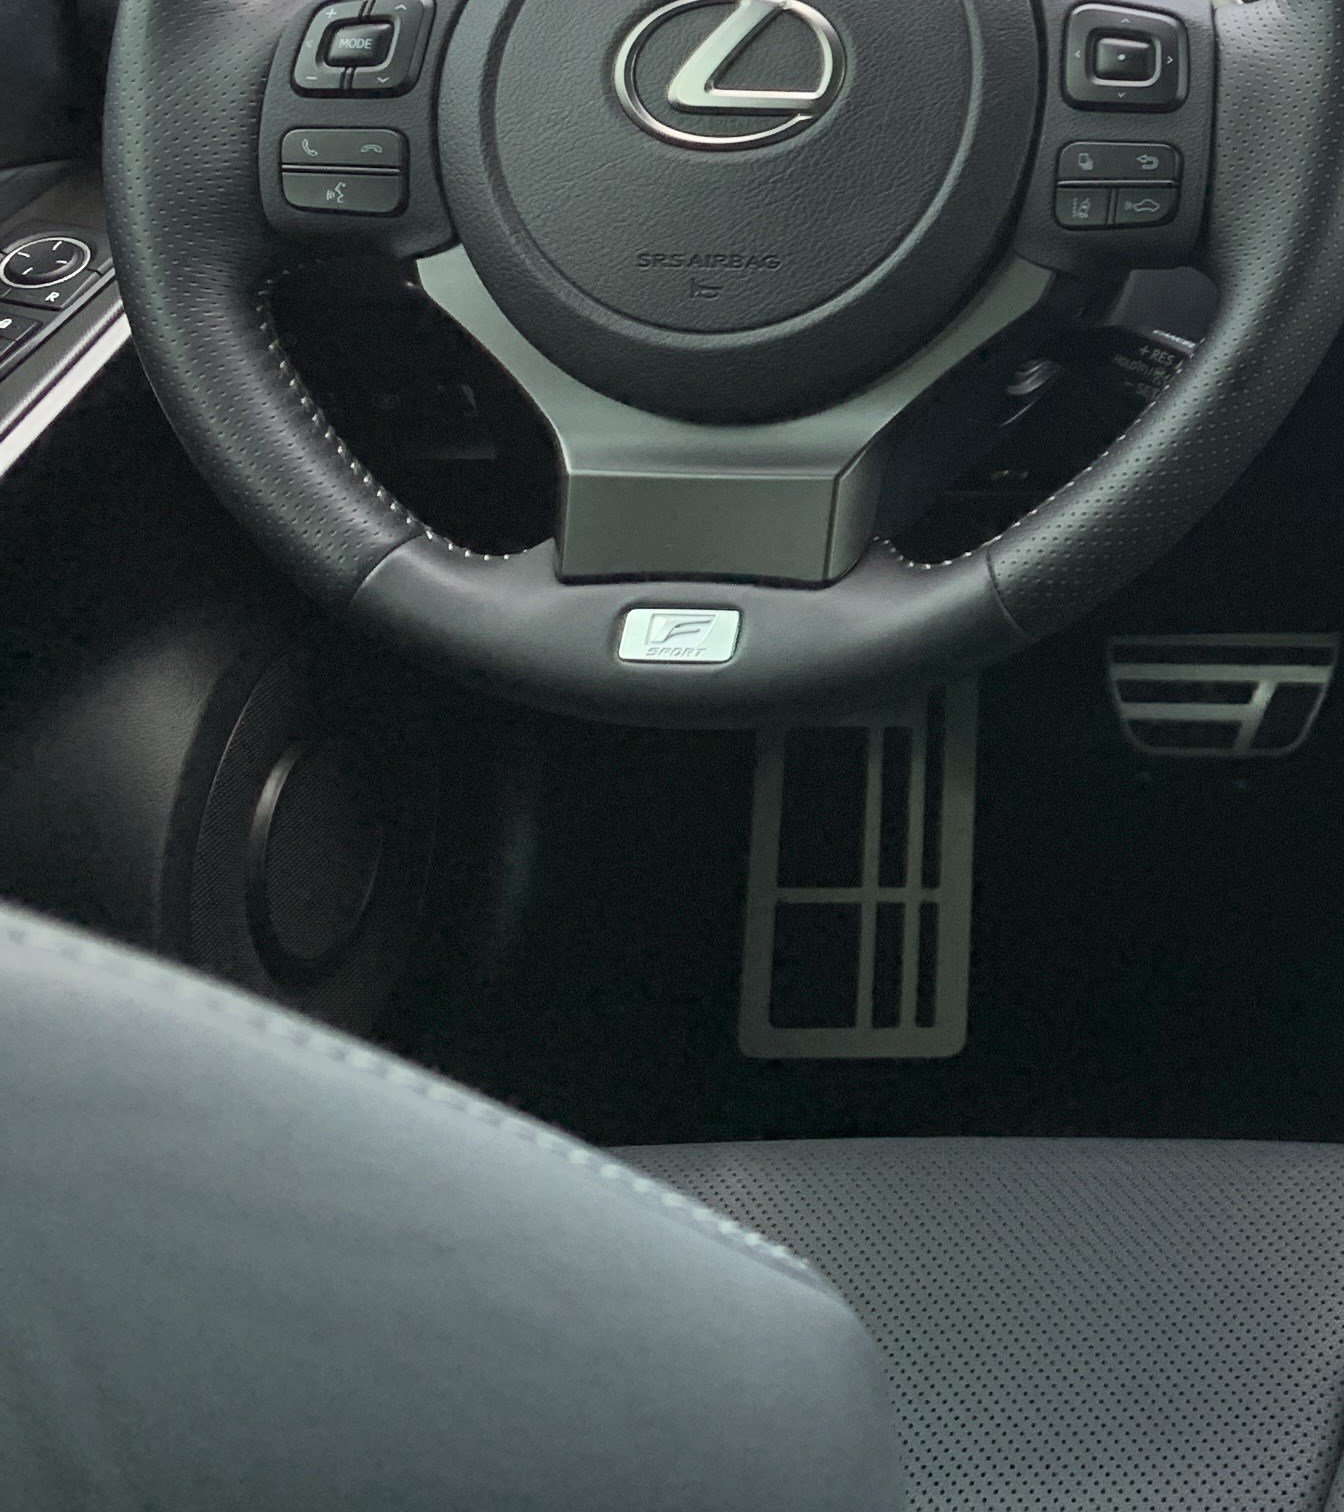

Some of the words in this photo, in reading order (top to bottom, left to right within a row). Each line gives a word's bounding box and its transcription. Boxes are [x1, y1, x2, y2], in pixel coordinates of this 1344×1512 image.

[340, 38, 372, 49] MODE
[637, 253, 686, 268] SRS
[687, 253, 782, 270] AIRBAG
[45, 291, 60, 302] R
[645, 647, 707, 657] SPORT
